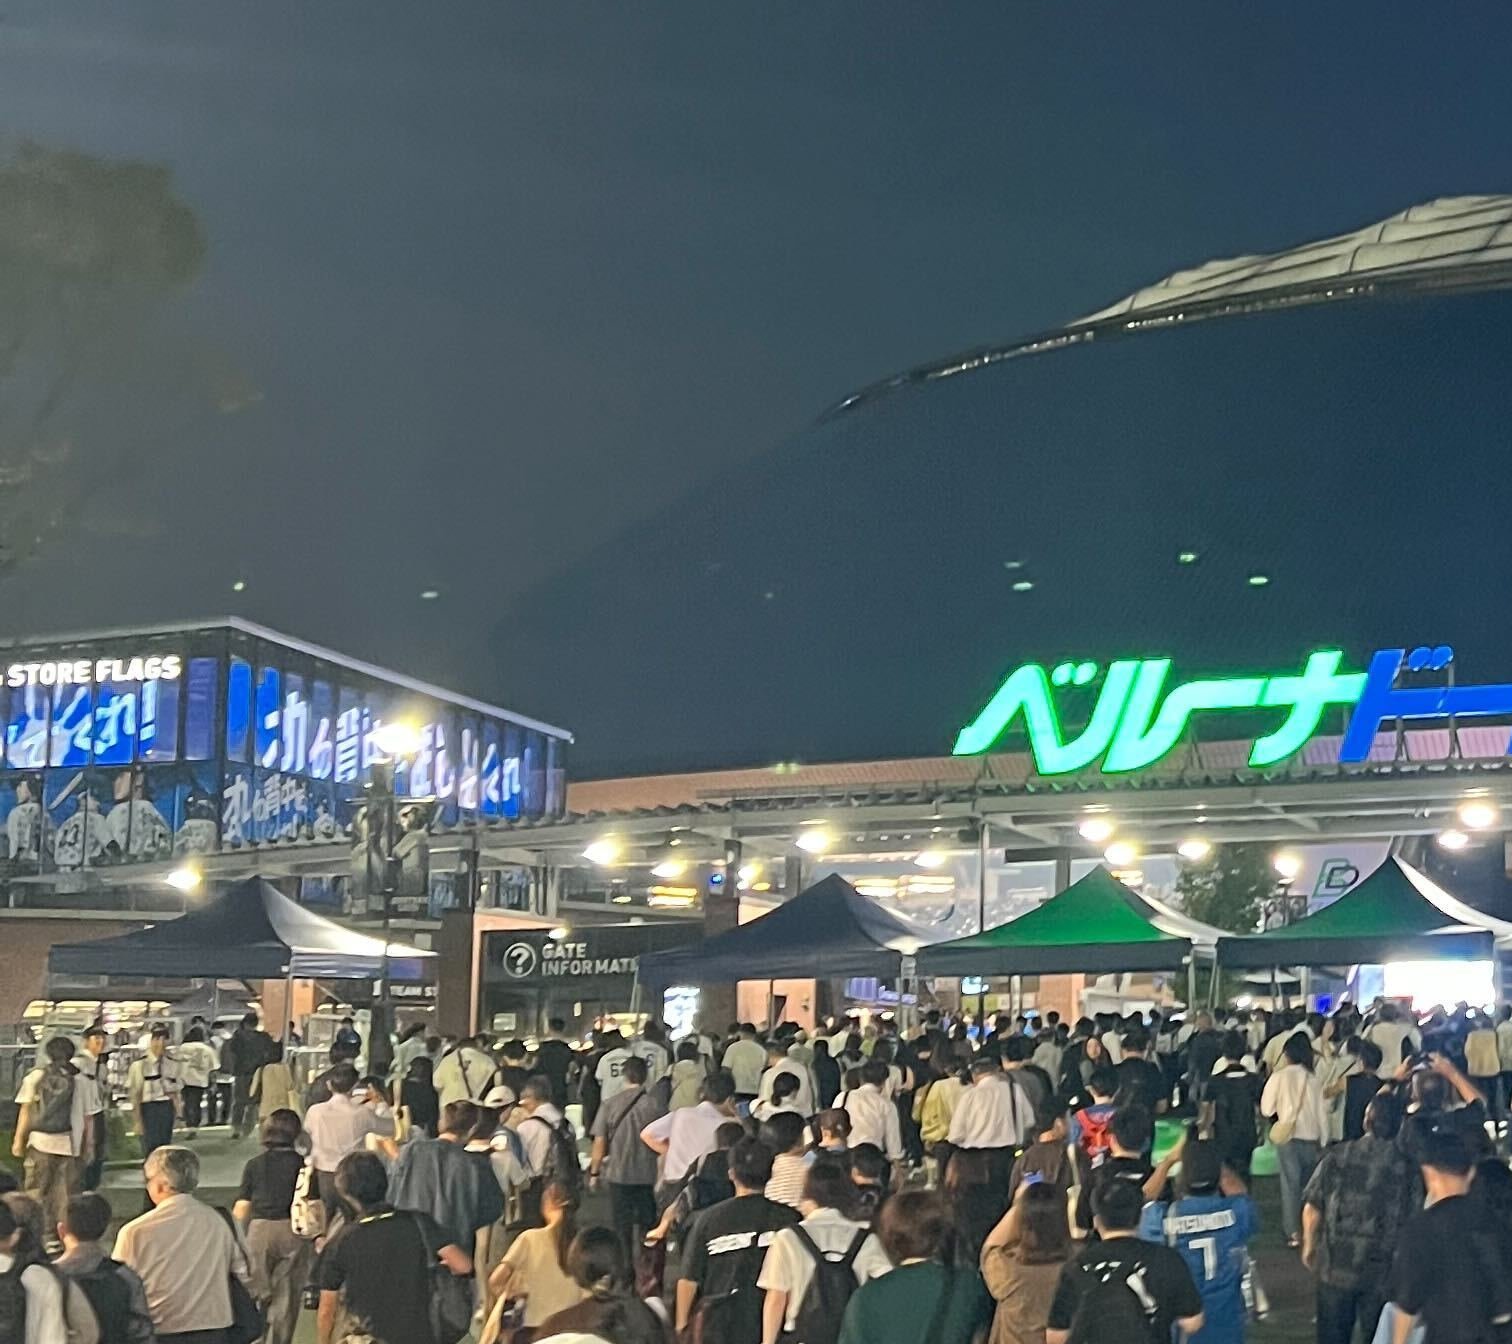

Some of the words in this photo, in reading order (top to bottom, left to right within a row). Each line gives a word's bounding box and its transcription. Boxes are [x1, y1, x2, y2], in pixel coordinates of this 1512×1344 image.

[7, 660, 92, 688] STORE
[96, 656, 182, 683] FLAGS
[542, 942, 587, 959] GATE
[1189, 1237, 1217, 1281] 7
